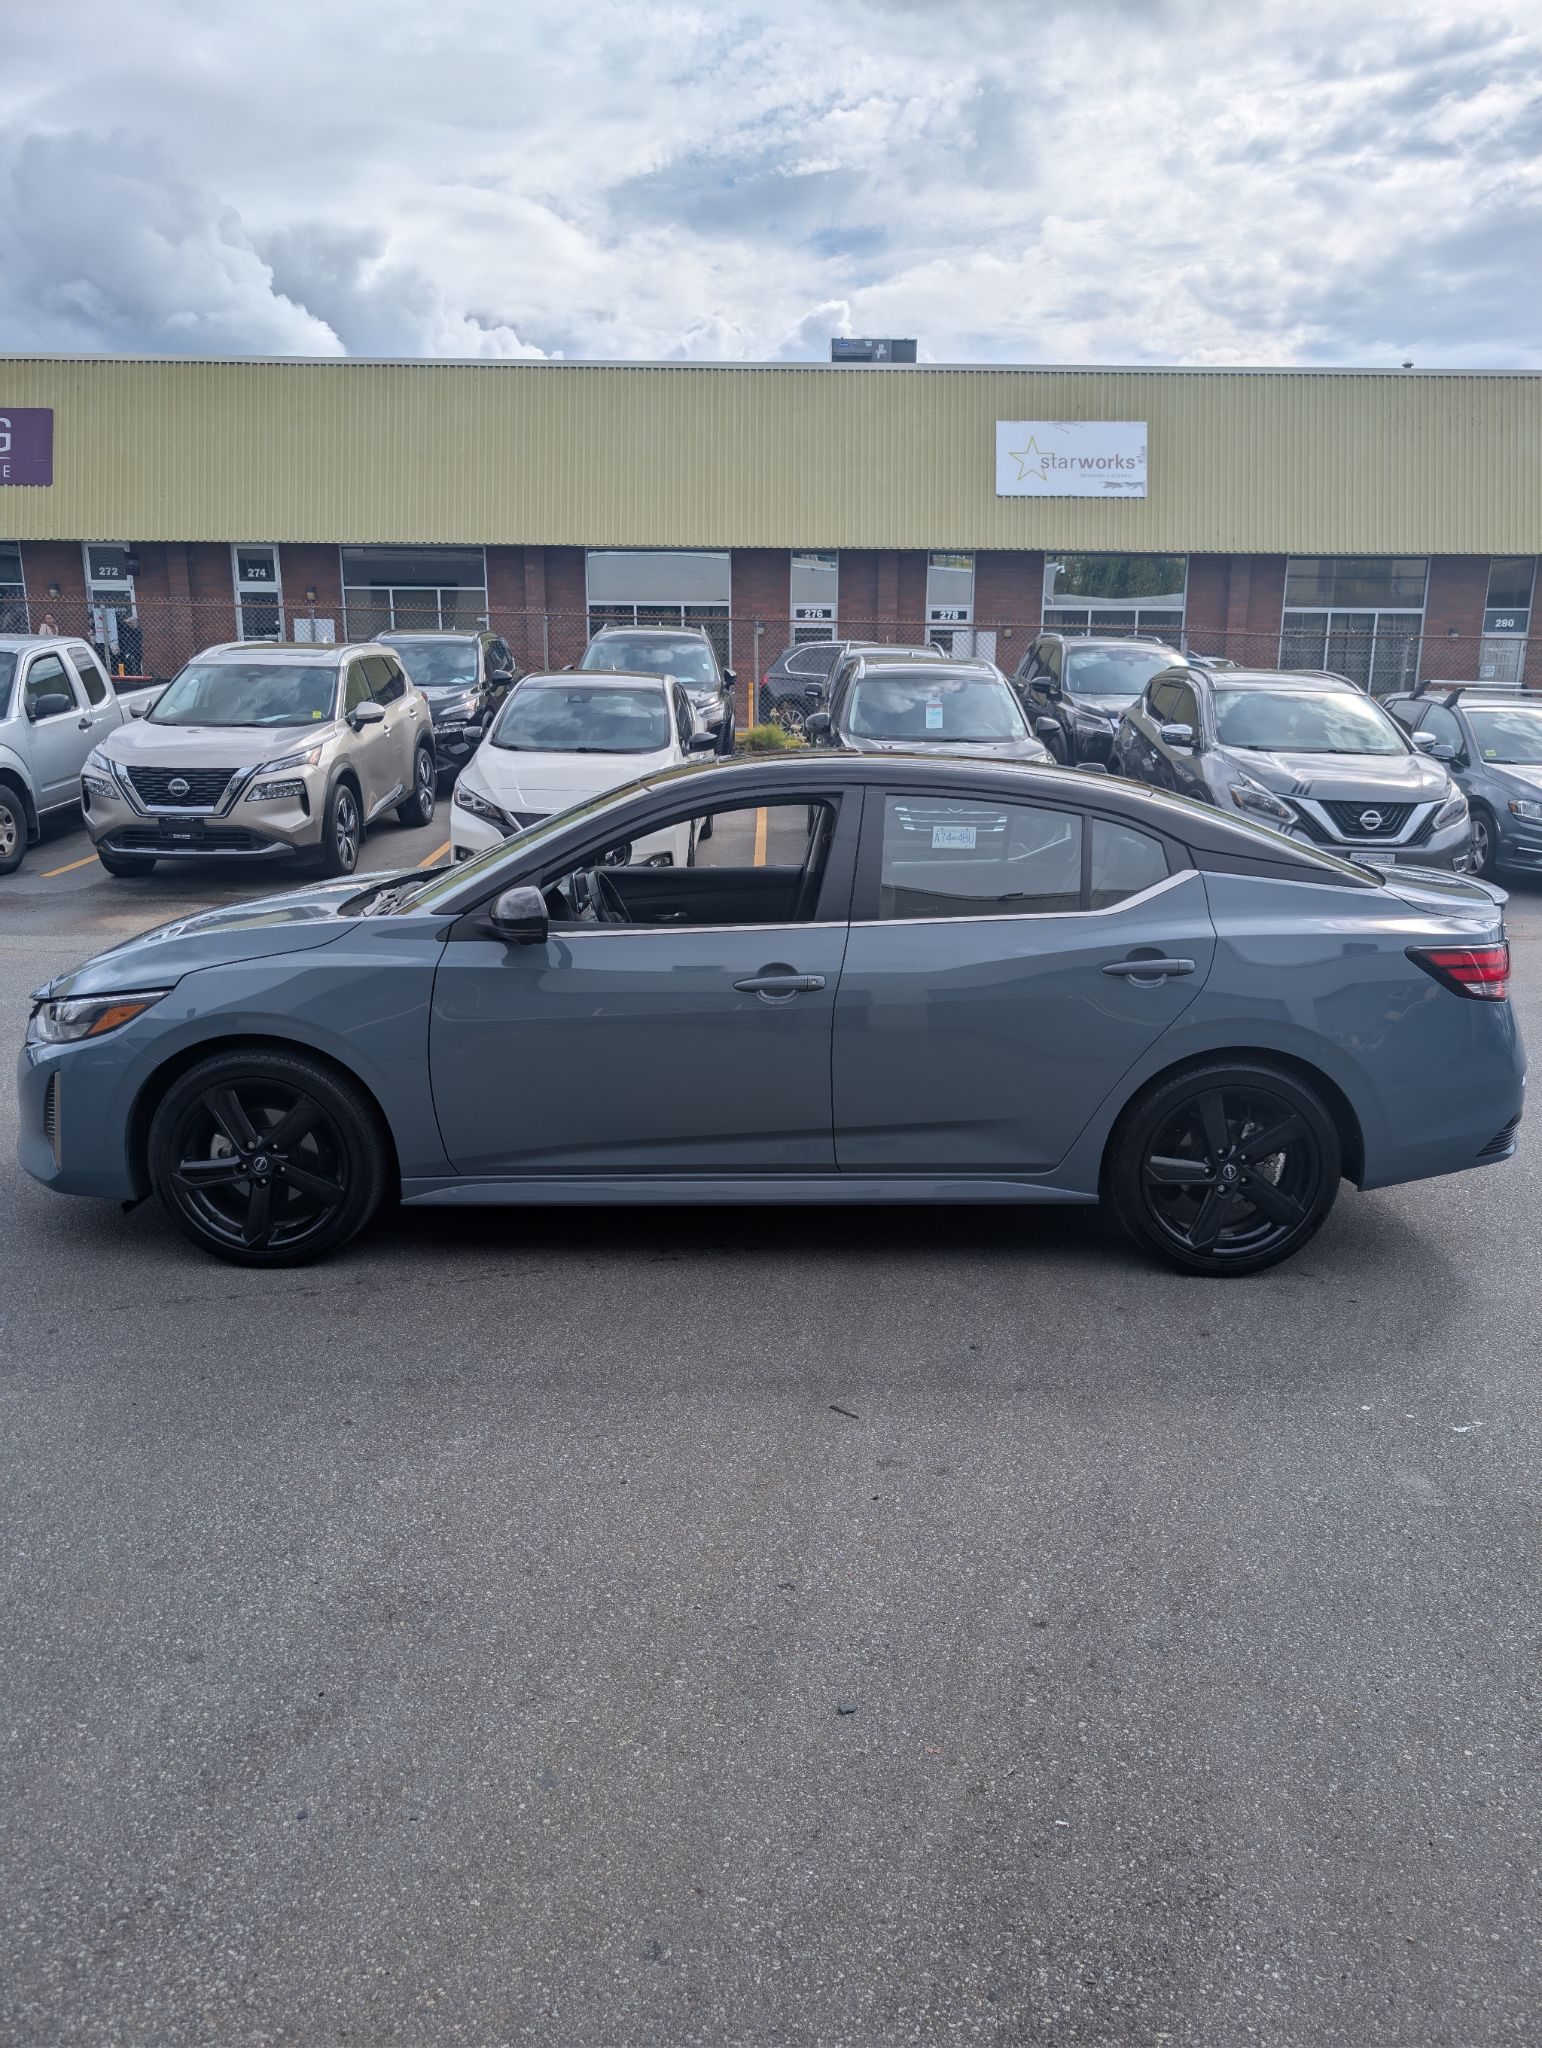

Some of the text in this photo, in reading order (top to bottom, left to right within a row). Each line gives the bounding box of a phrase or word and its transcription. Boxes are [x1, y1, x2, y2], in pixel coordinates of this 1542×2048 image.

[1040, 453, 1136, 470] starworks
[98, 566, 119, 576] 272
[247, 568, 267, 578] 274
[804, 609, 824, 618] 276
[939, 611, 959, 620] 278
[1494, 618, 1515, 628] 280
